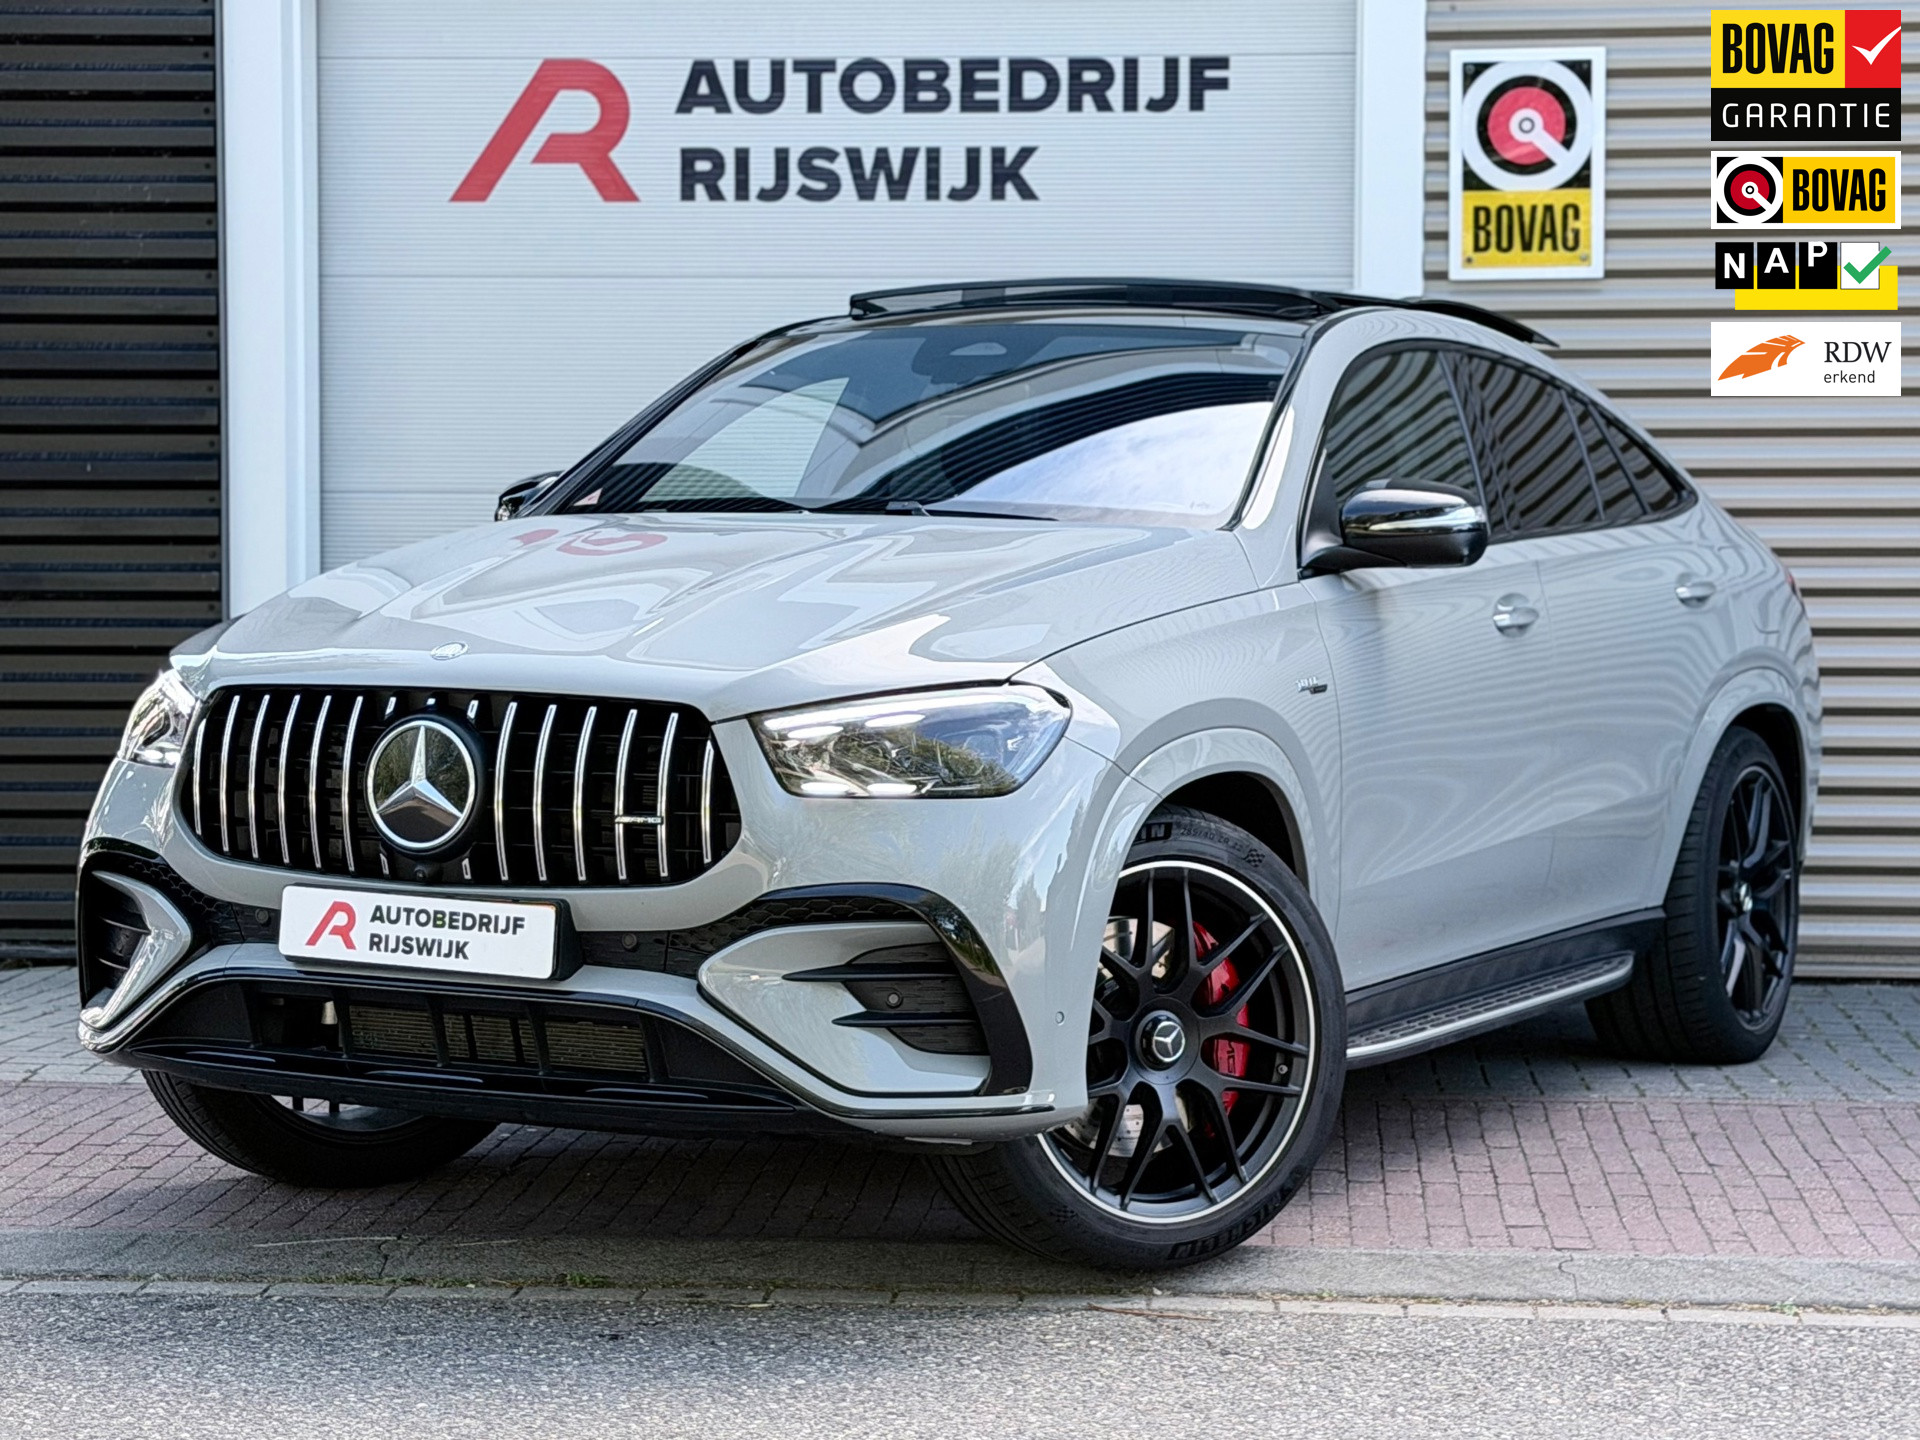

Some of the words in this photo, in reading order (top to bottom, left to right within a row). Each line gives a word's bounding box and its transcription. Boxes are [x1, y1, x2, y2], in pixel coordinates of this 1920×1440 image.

[675, 56, 1230, 115] AUTOBEDRIJF
[679, 146, 1040, 202] RIJSWIJK
[1473, 203, 1580, 253] BOVAG
[370, 905, 525, 935] AUTOBEDRIJF
[369, 933, 469, 960] RIJSWIJK
